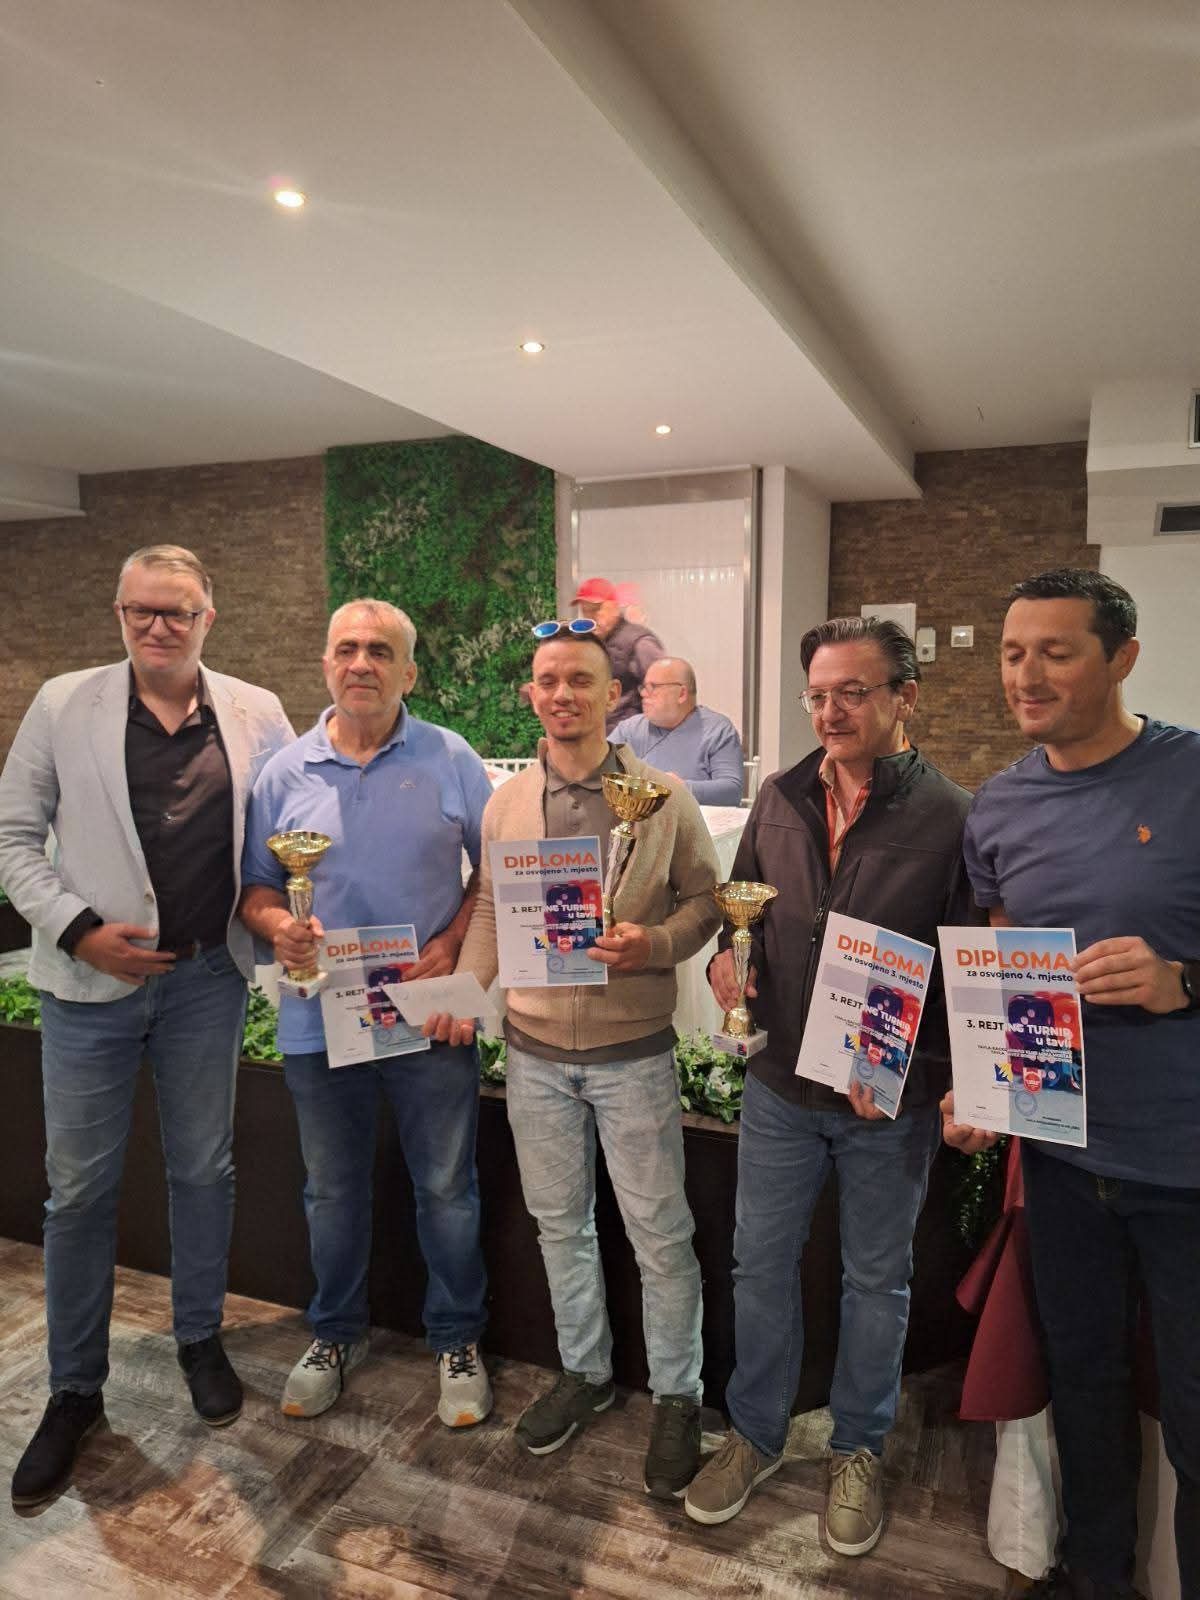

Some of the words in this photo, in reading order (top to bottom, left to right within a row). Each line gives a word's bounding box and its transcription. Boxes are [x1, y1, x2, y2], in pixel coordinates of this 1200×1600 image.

[504, 852, 597, 869] DIPLOMA
[525, 867, 562, 877] osvojeno
[570, 866, 598, 875] mjesto
[511, 906, 520, 914] 3.
[327, 937, 412, 957] DIPLOMA
[837, 934, 925, 980] DIPLOMA
[956, 948, 1071, 971] DIPLOMA
[843, 953, 853, 962] za
[854, 958, 890, 975] osvojeno
[890, 969, 898, 978] 3.
[899, 975, 924, 990] mjesto
[979, 970, 1024, 981] osvojeno
[1025, 971, 1036, 980] 4.
[1038, 972, 1073, 983] mjesto
[829, 992, 838, 1002] 3.
[966, 1019, 976, 1028] 3.
[1035, 1037, 1044, 1046] u
